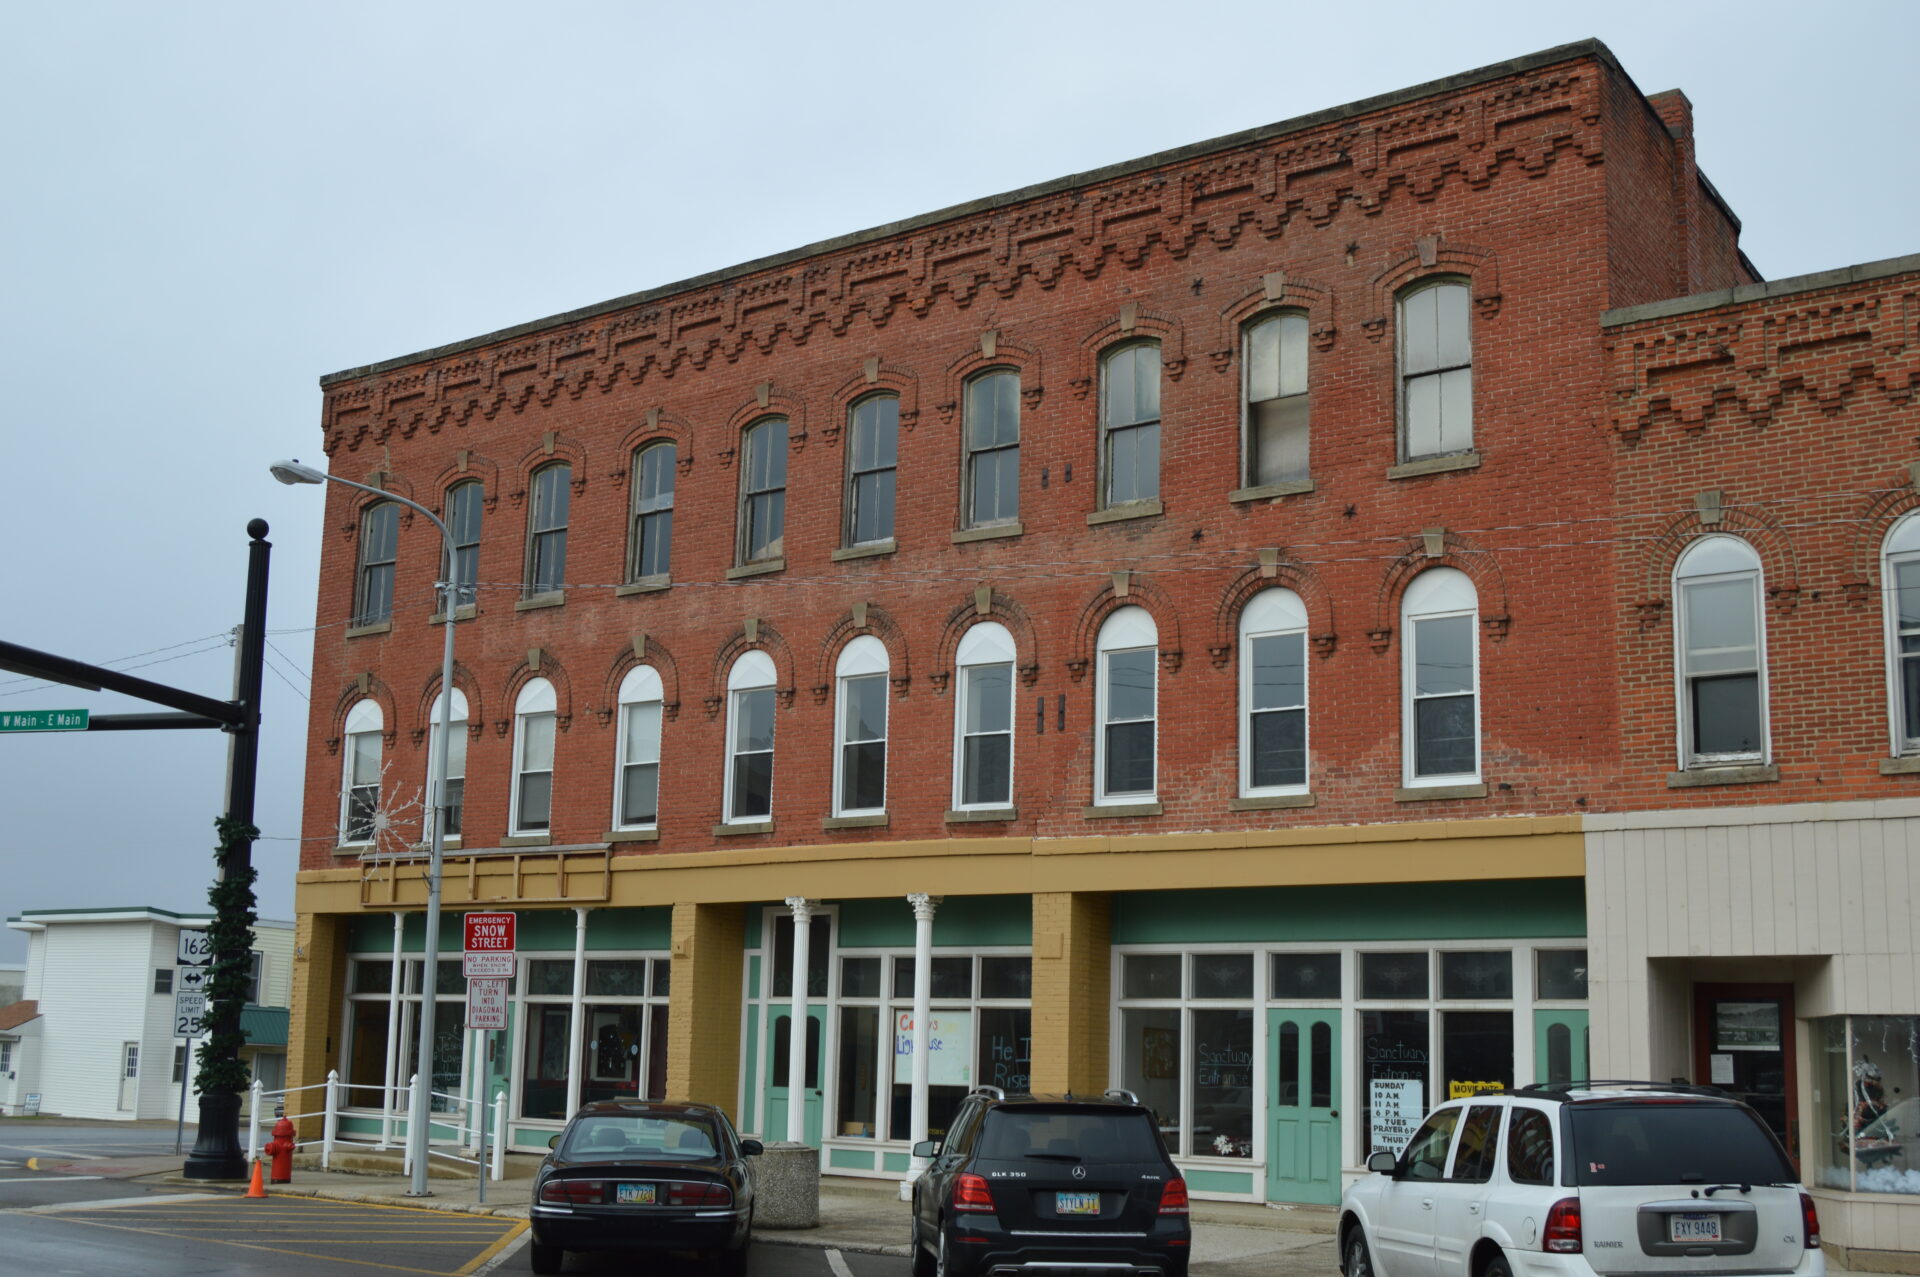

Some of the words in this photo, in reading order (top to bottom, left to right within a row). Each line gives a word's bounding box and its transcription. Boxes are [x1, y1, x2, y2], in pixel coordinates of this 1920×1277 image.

[3, 715, 11, 727] W
[14, 714, 37, 727] Main
[47, 713, 54, 726] E
[57, 713, 81, 726] Main
[474, 925, 506, 937] SNOW
[184, 938, 210, 955] 162
[471, 937, 508, 948] STREET
[472, 980, 483, 988] NO
[487, 980, 504, 988] LEFT
[479, 988, 498, 996] TURN
[179, 996, 203, 1005] SPEED
[181, 1006, 200, 1014] LIMIT
[177, 1017, 201, 1034] 25
[992, 1035, 1013, 1061] He
[1367, 1038, 1428, 1064] Sanctuary
[1198, 1041, 1253, 1071] Sanctuary
[1199, 1068, 1249, 1085] Entrance
[1454, 1085, 1478, 1094] MOVIE
[1373, 1125, 1403, 1133] PRAYER
[1675, 1221, 1691, 1234] FXY
[1694, 1221, 1717, 1235] 9448
